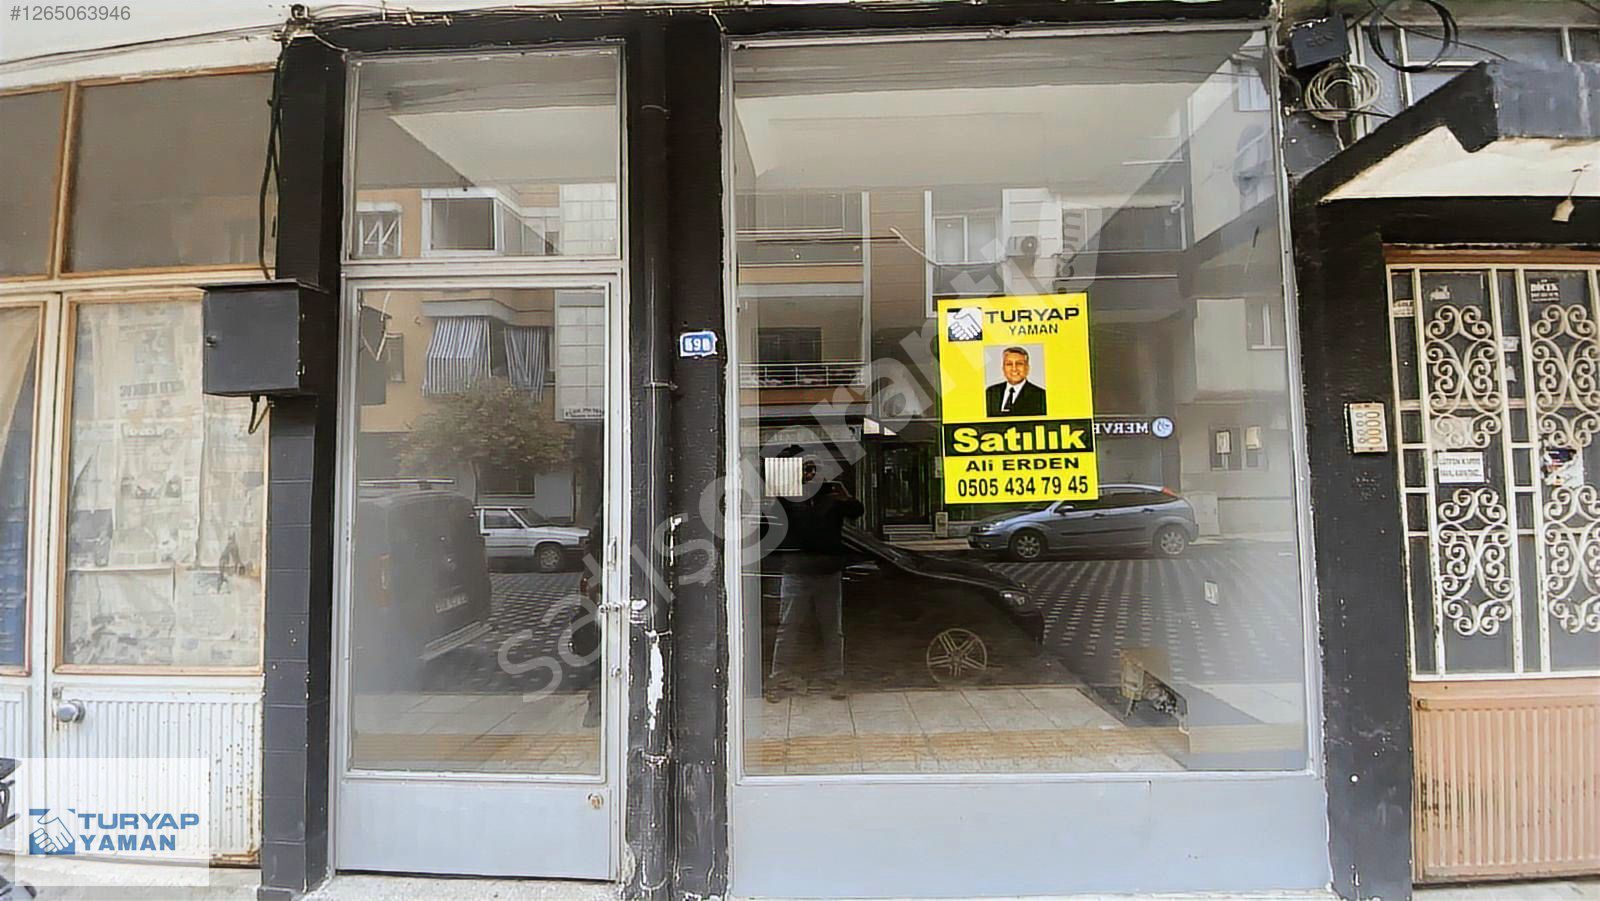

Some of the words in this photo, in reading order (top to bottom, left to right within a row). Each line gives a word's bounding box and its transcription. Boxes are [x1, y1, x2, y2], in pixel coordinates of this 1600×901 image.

[985, 307, 1080, 324] TURYAP
[1009, 324, 1058, 336] YAMAN
[953, 424, 1087, 453] Satılık
[966, 459, 993, 472] Ali
[1002, 457, 1079, 471] ERDEN
[958, 477, 998, 497] 0505
[1005, 477, 1035, 496] 434
[1042, 477, 1061, 495] 79
[1068, 475, 1088, 494] 45
